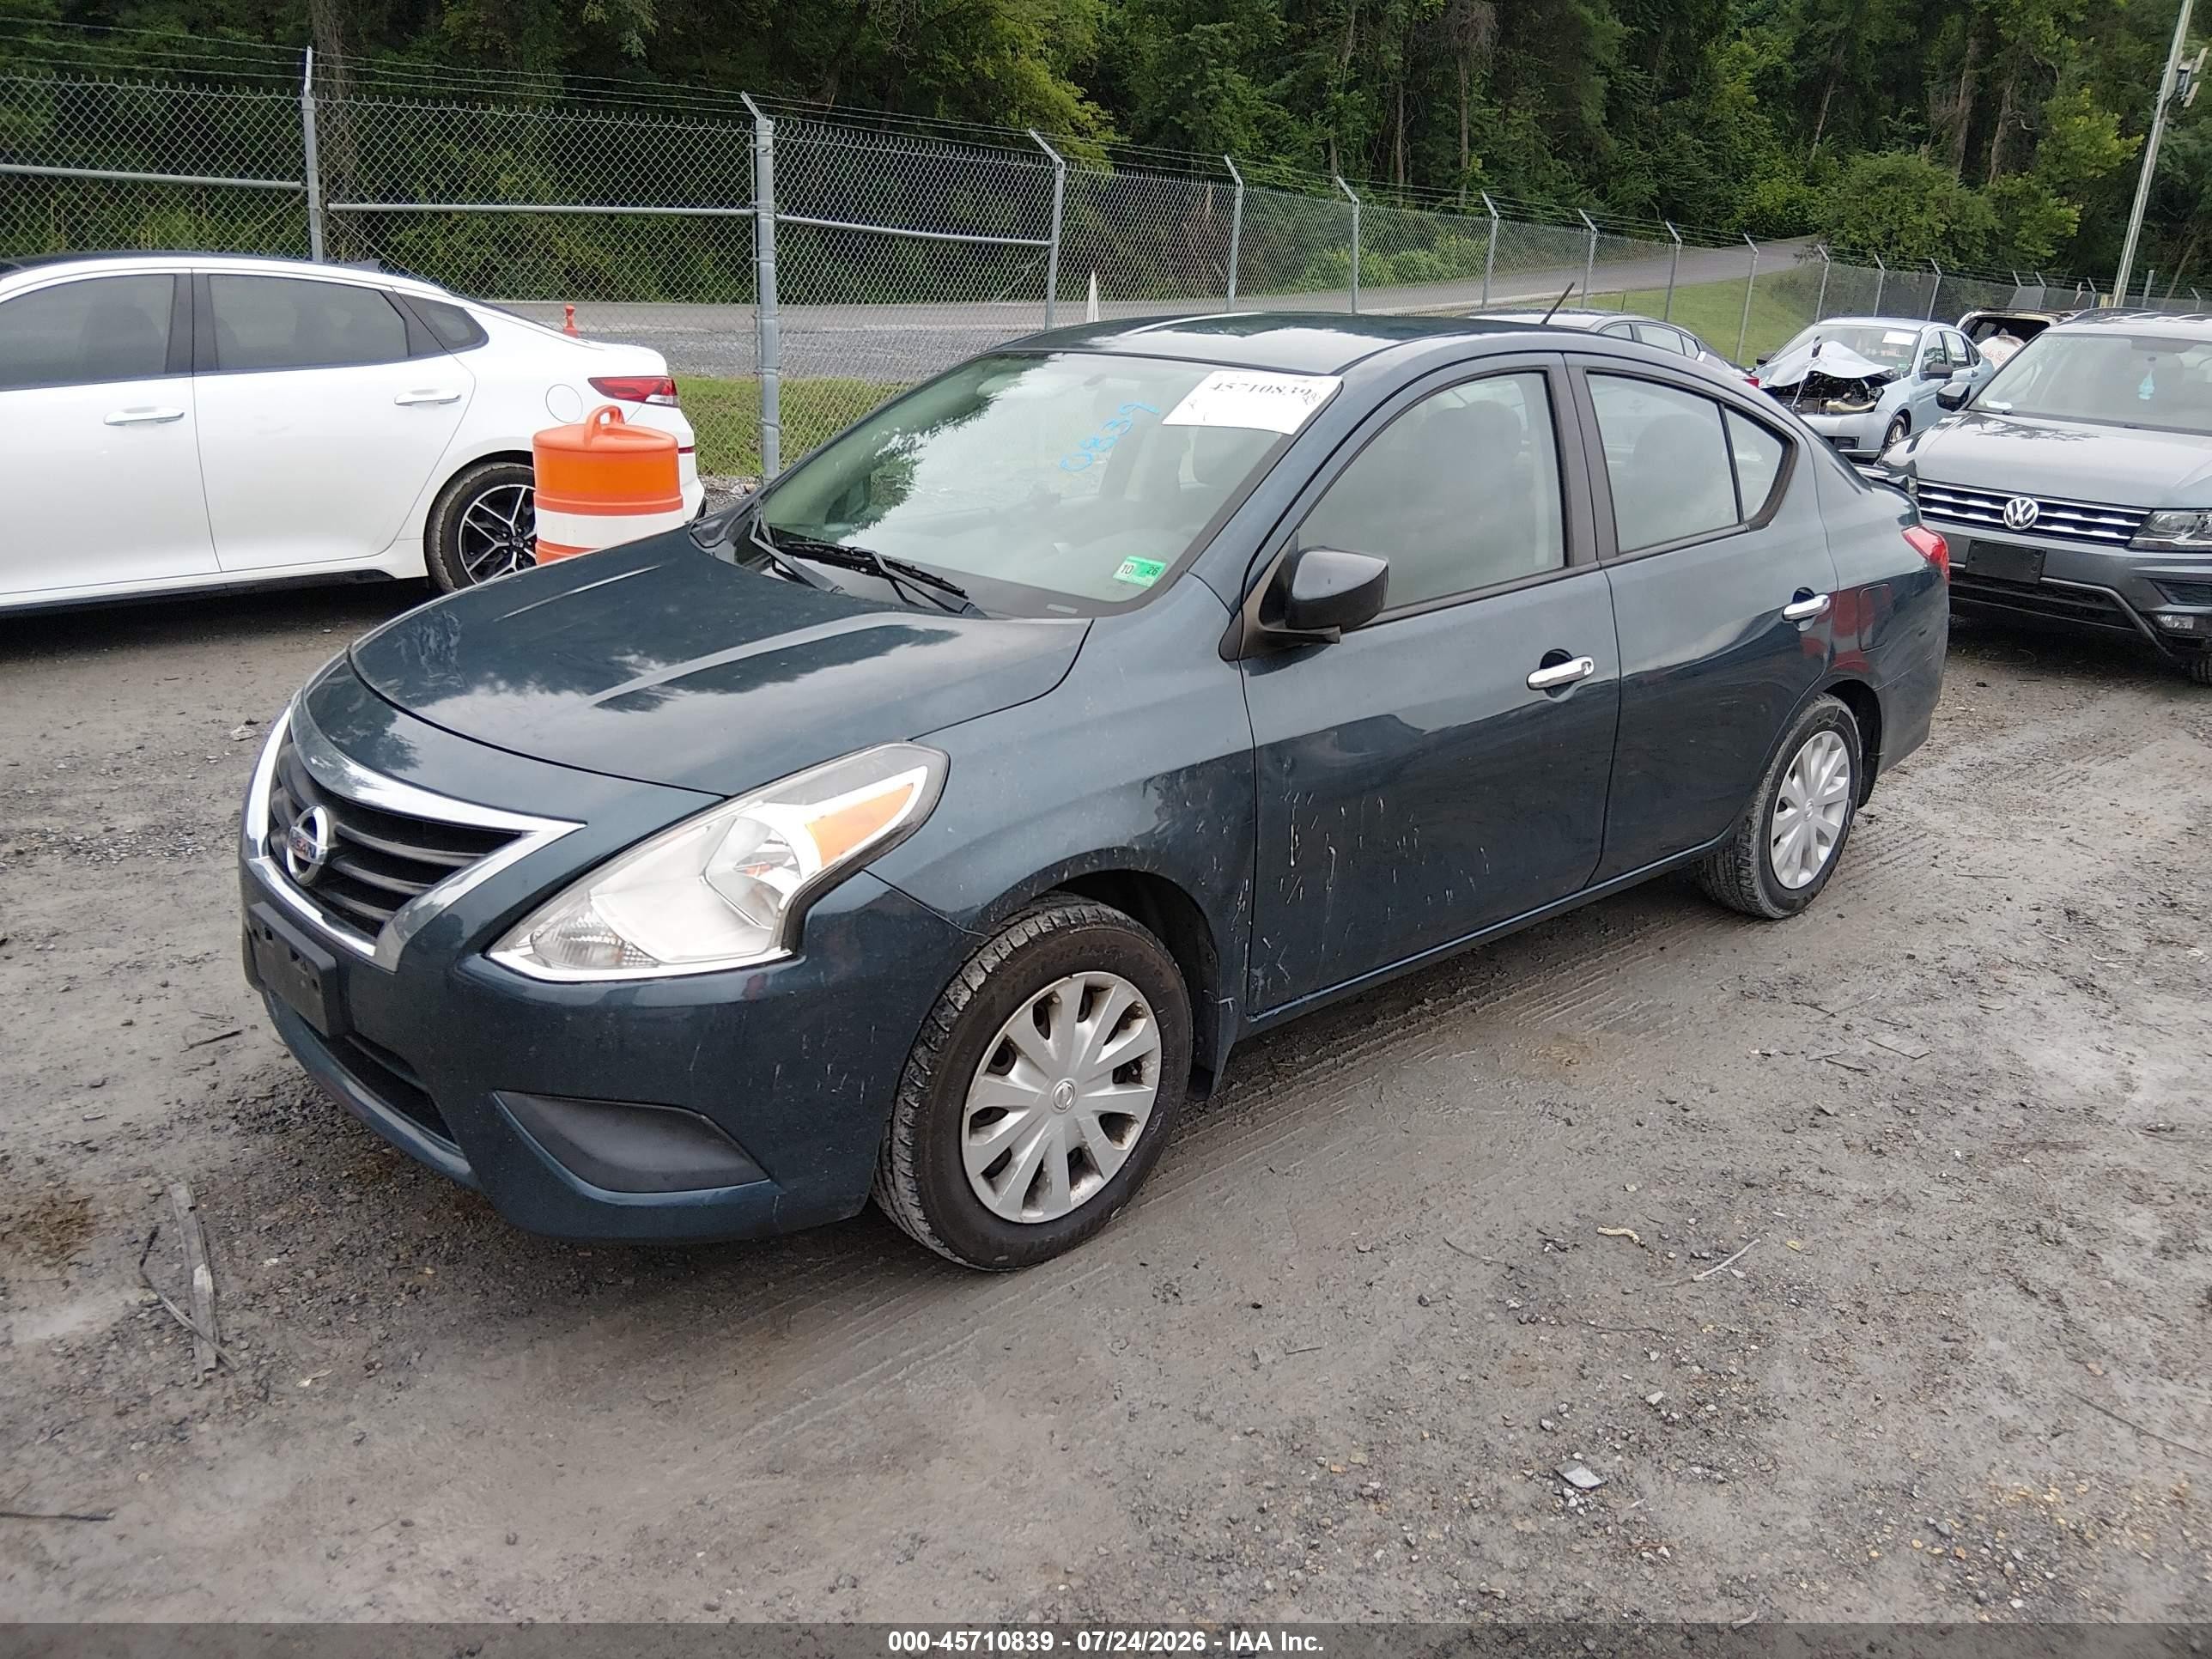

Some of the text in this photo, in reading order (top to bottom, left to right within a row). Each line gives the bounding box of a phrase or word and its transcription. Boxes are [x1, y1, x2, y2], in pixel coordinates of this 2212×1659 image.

[1060, 402, 1160, 472] 0839
[1120, 563, 1161, 576] 10 26
